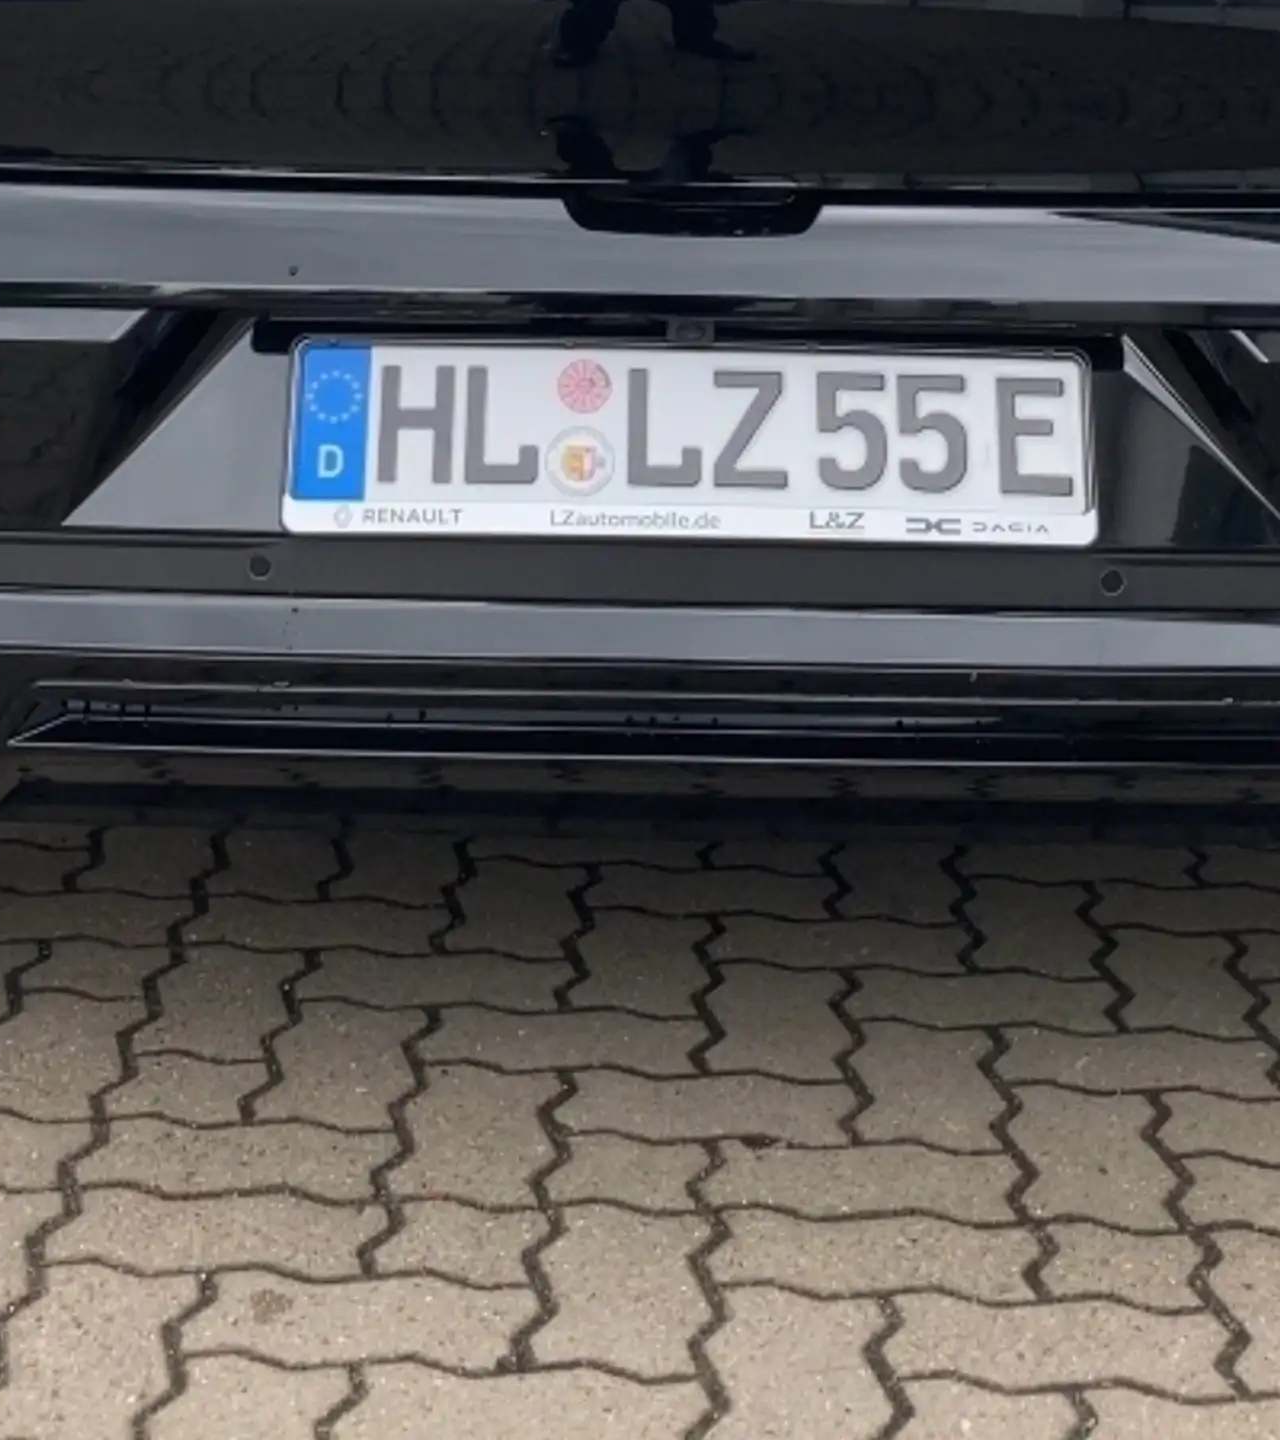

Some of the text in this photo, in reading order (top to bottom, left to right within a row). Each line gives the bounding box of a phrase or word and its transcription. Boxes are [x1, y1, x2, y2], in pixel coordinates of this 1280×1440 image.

[376, 364, 539, 485] HL
[318, 444, 344, 478] D
[362, 508, 463, 526] RENAULT
[549, 510, 721, 530] LZautomobile.de
[809, 511, 865, 530] L&Z
